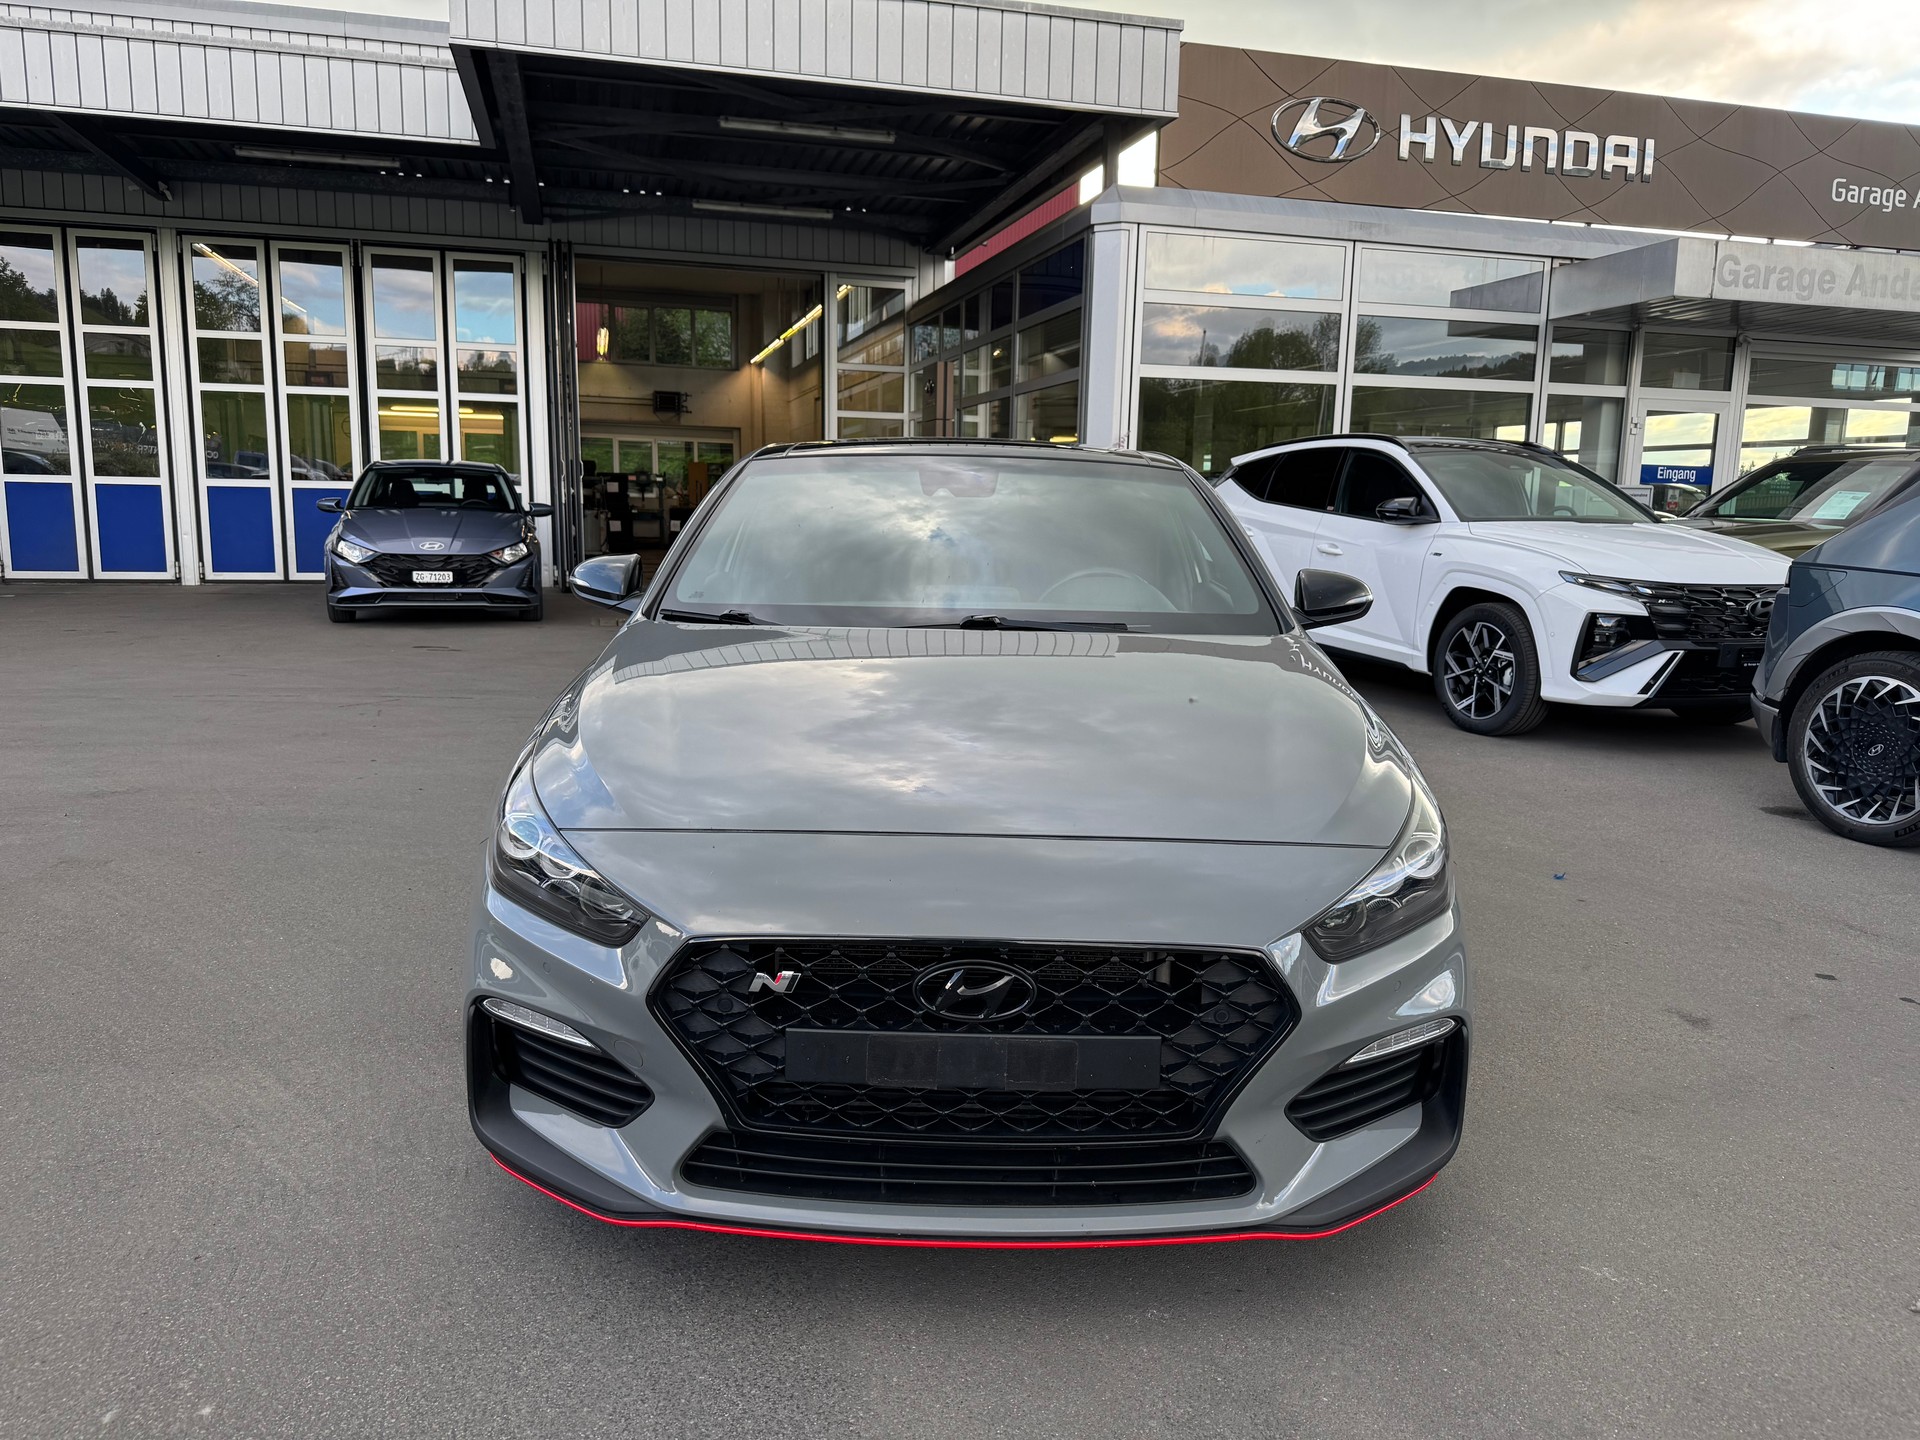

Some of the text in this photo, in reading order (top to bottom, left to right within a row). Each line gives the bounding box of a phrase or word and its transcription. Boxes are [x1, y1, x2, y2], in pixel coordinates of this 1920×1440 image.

[1398, 113, 1655, 183] HYUNDAI
[1831, 177, 1907, 213] Garage
[1717, 253, 1837, 301] Garage
[1656, 466, 1696, 482] Eingang
[748, 970, 801, 993] N
